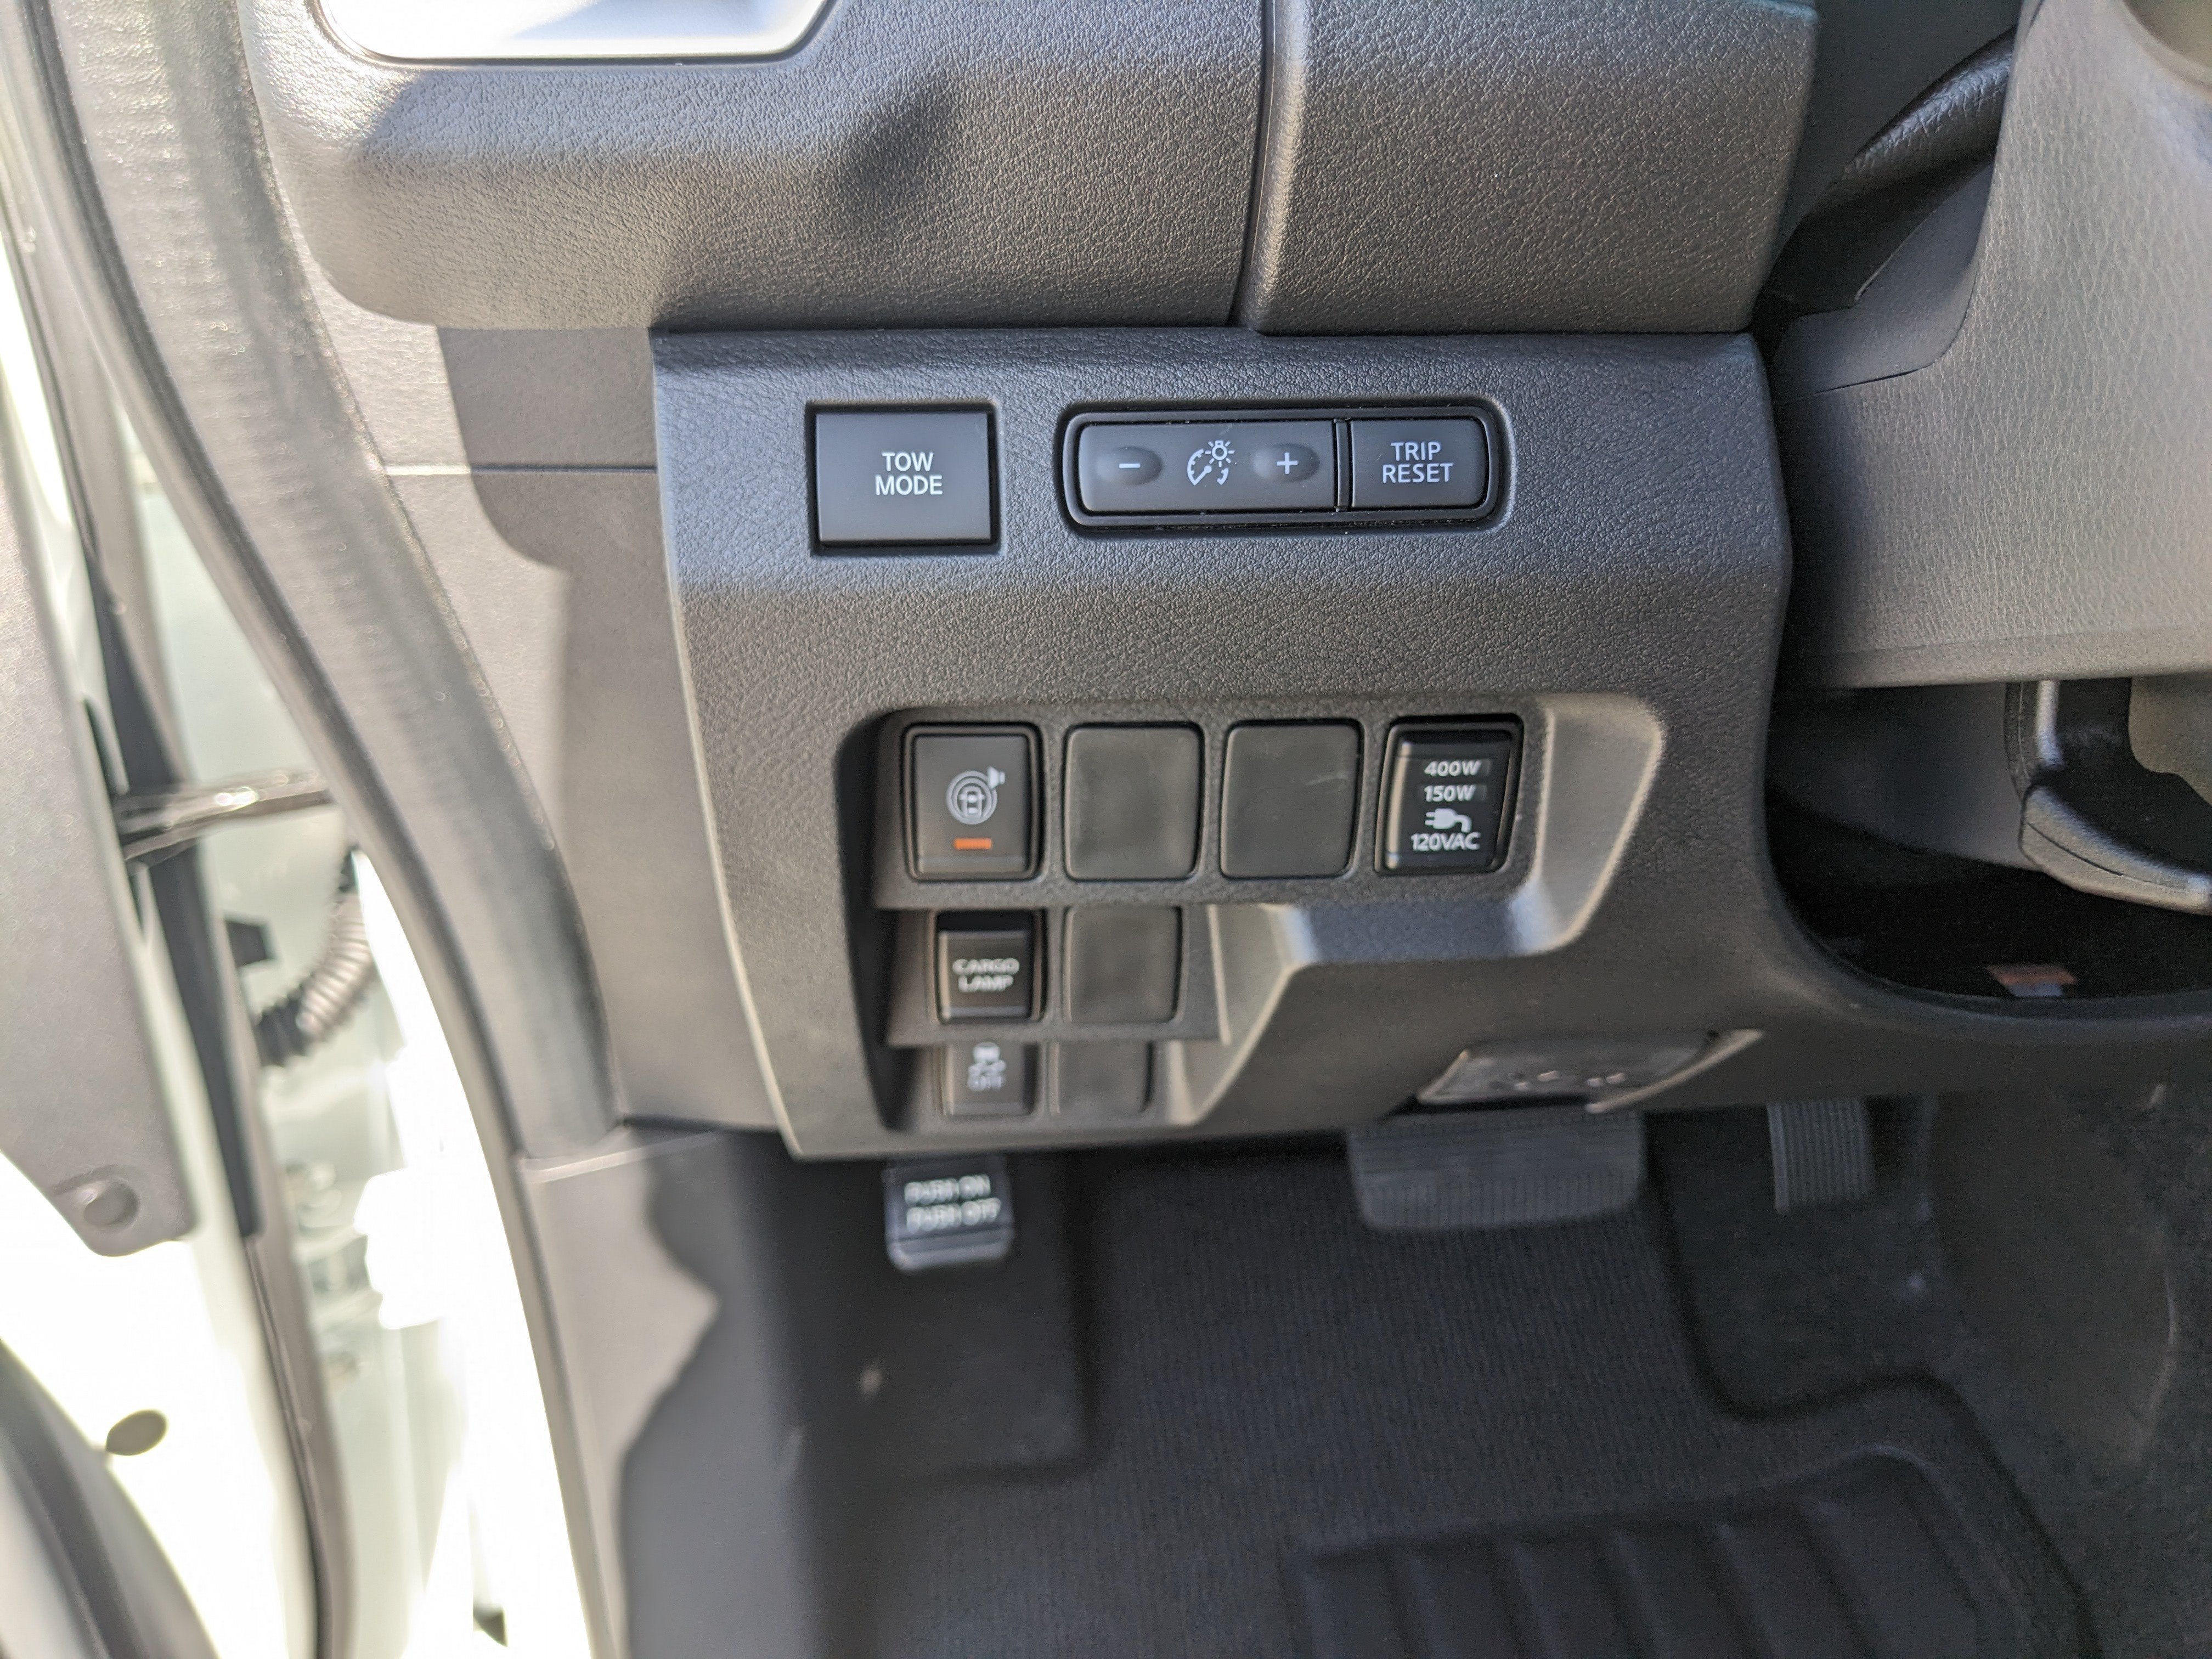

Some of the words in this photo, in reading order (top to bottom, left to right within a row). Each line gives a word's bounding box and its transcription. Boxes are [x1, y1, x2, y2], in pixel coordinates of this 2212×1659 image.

[1390, 442, 1441, 461] TRIP
[881, 452, 934, 472] TOW
[1382, 462, 1454, 483] RESET
[875, 475, 943, 495] MODE
[1424, 760, 1481, 776] 400W
[1424, 785, 1476, 802] 150W
[1410, 832, 1481, 851] 120VAC
[952, 958, 1020, 975] CARGO
[958, 974, 1014, 992] LAMP
